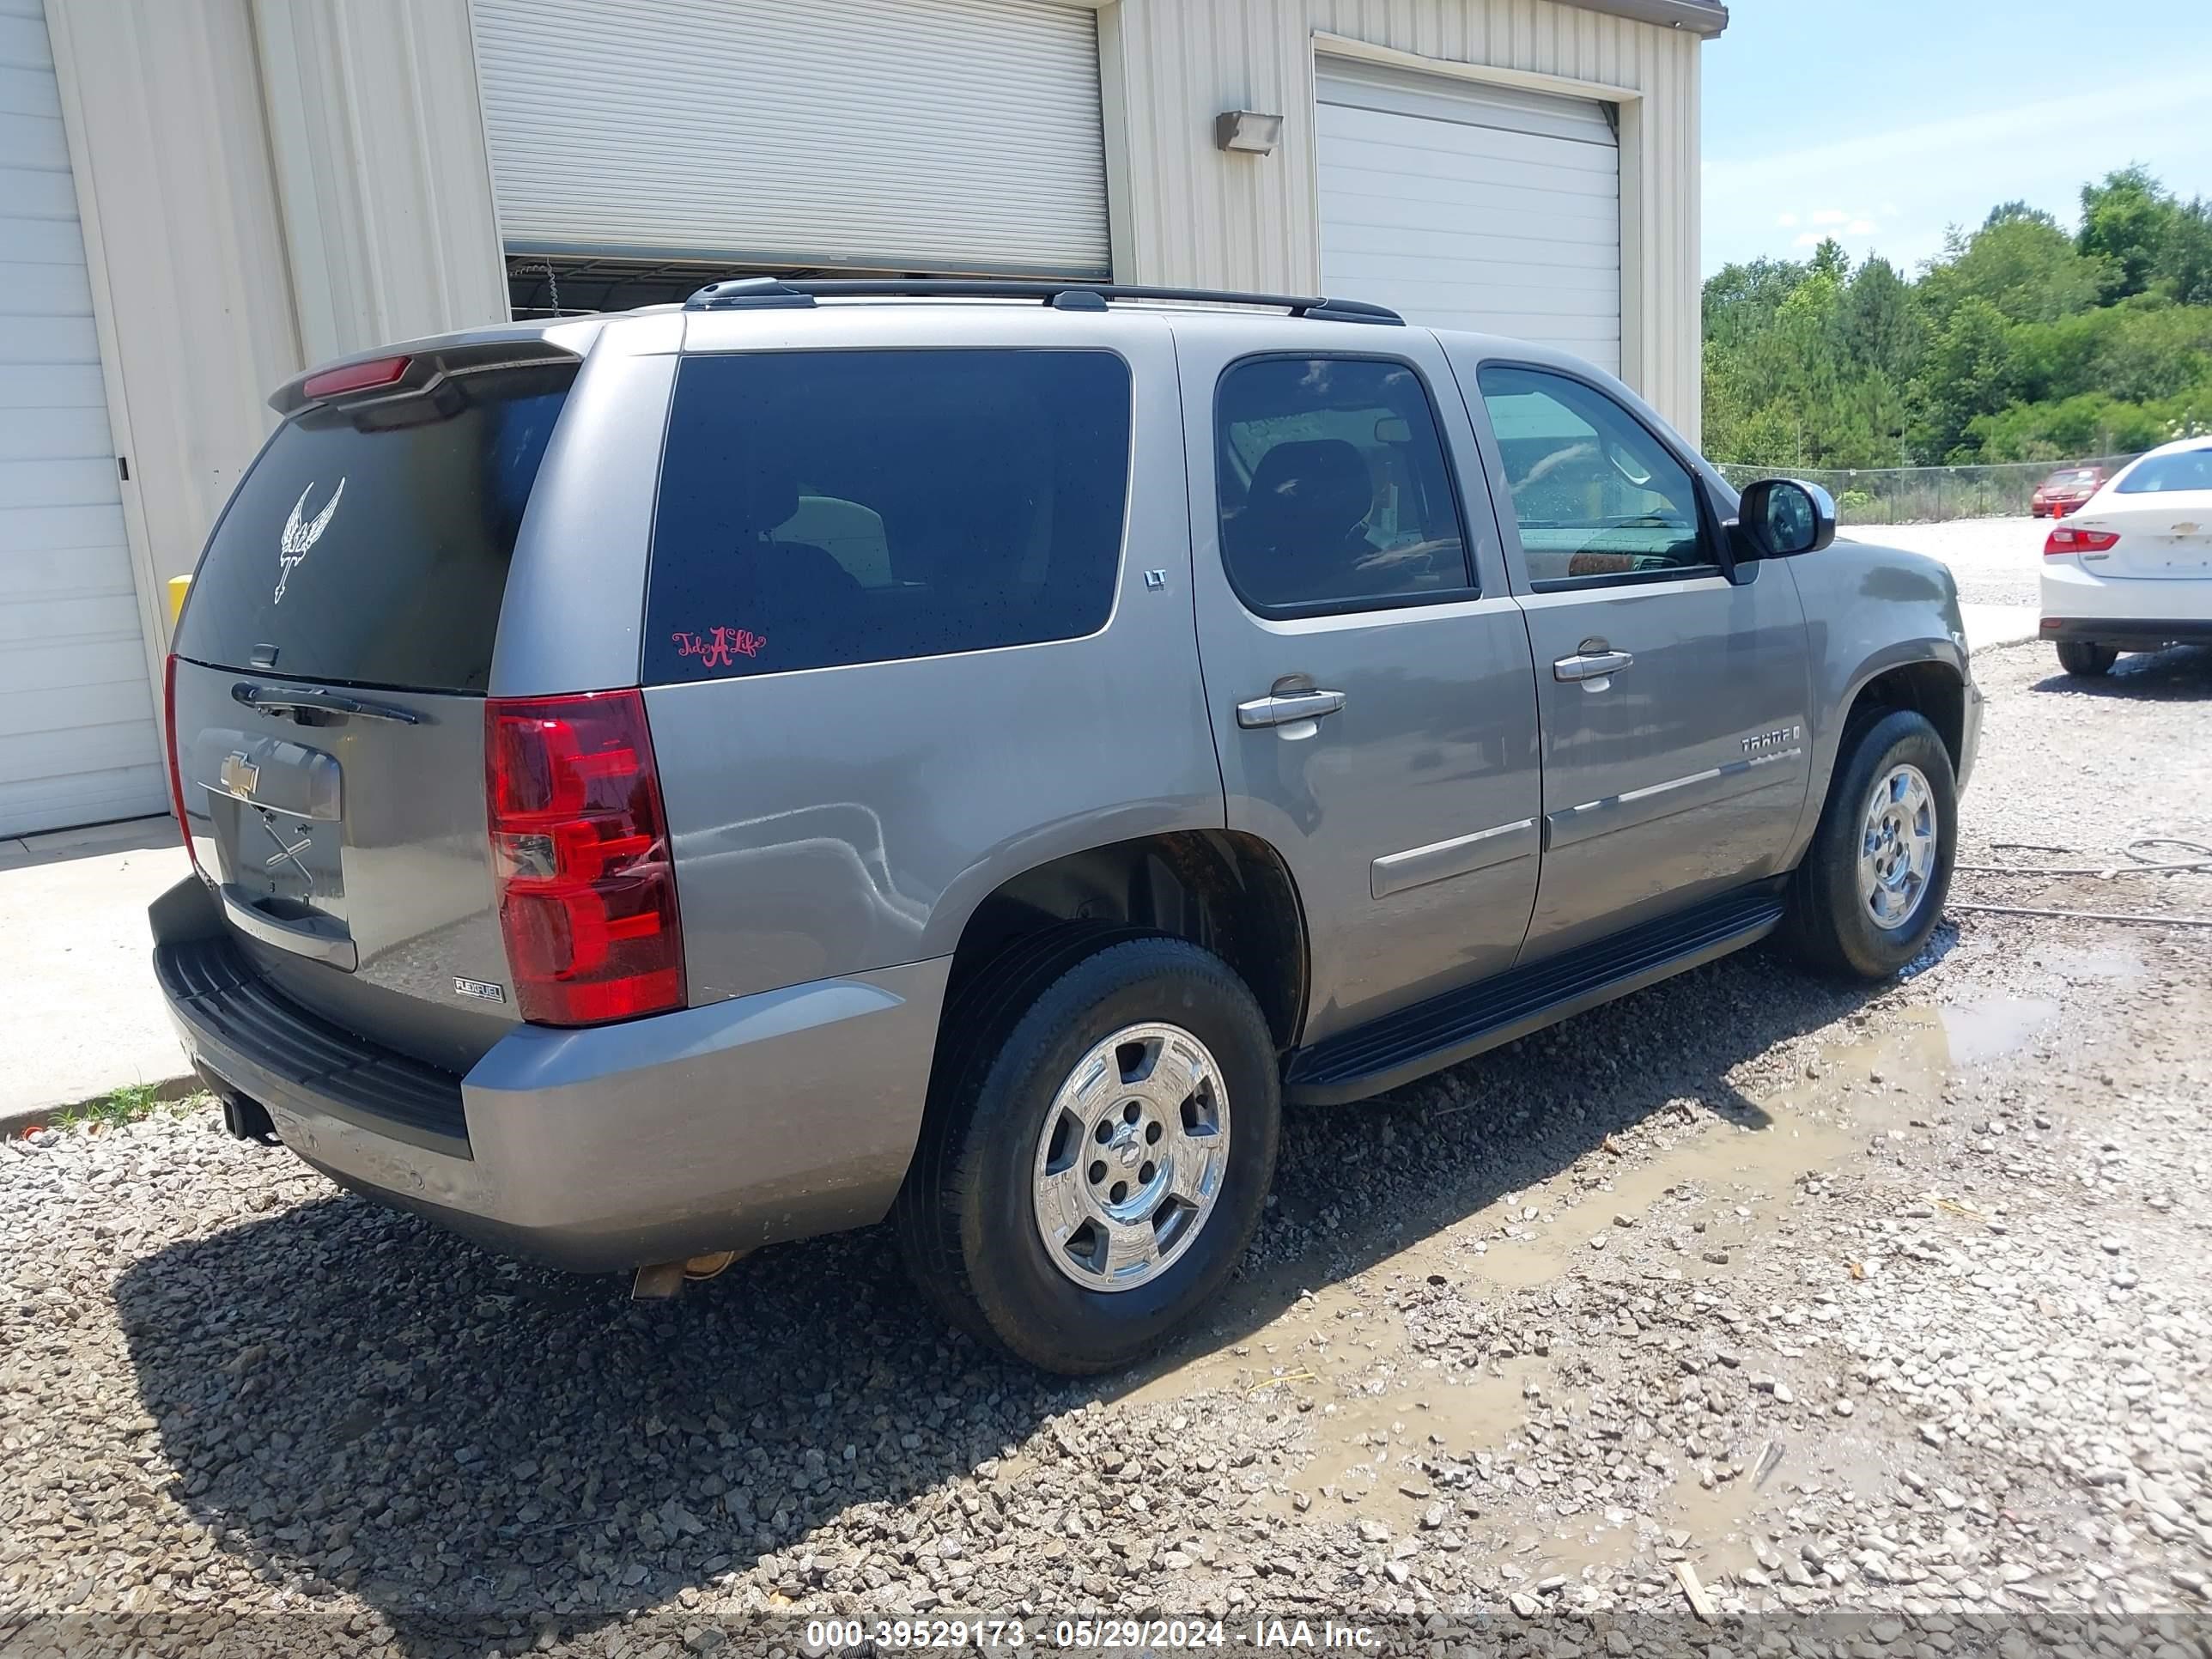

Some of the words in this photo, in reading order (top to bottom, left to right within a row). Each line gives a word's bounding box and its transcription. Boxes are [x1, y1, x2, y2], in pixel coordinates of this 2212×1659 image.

[1144, 569, 1166, 586] LT
[702, 626, 732, 667] A
[455, 980, 501, 998] FLEXFUEL
